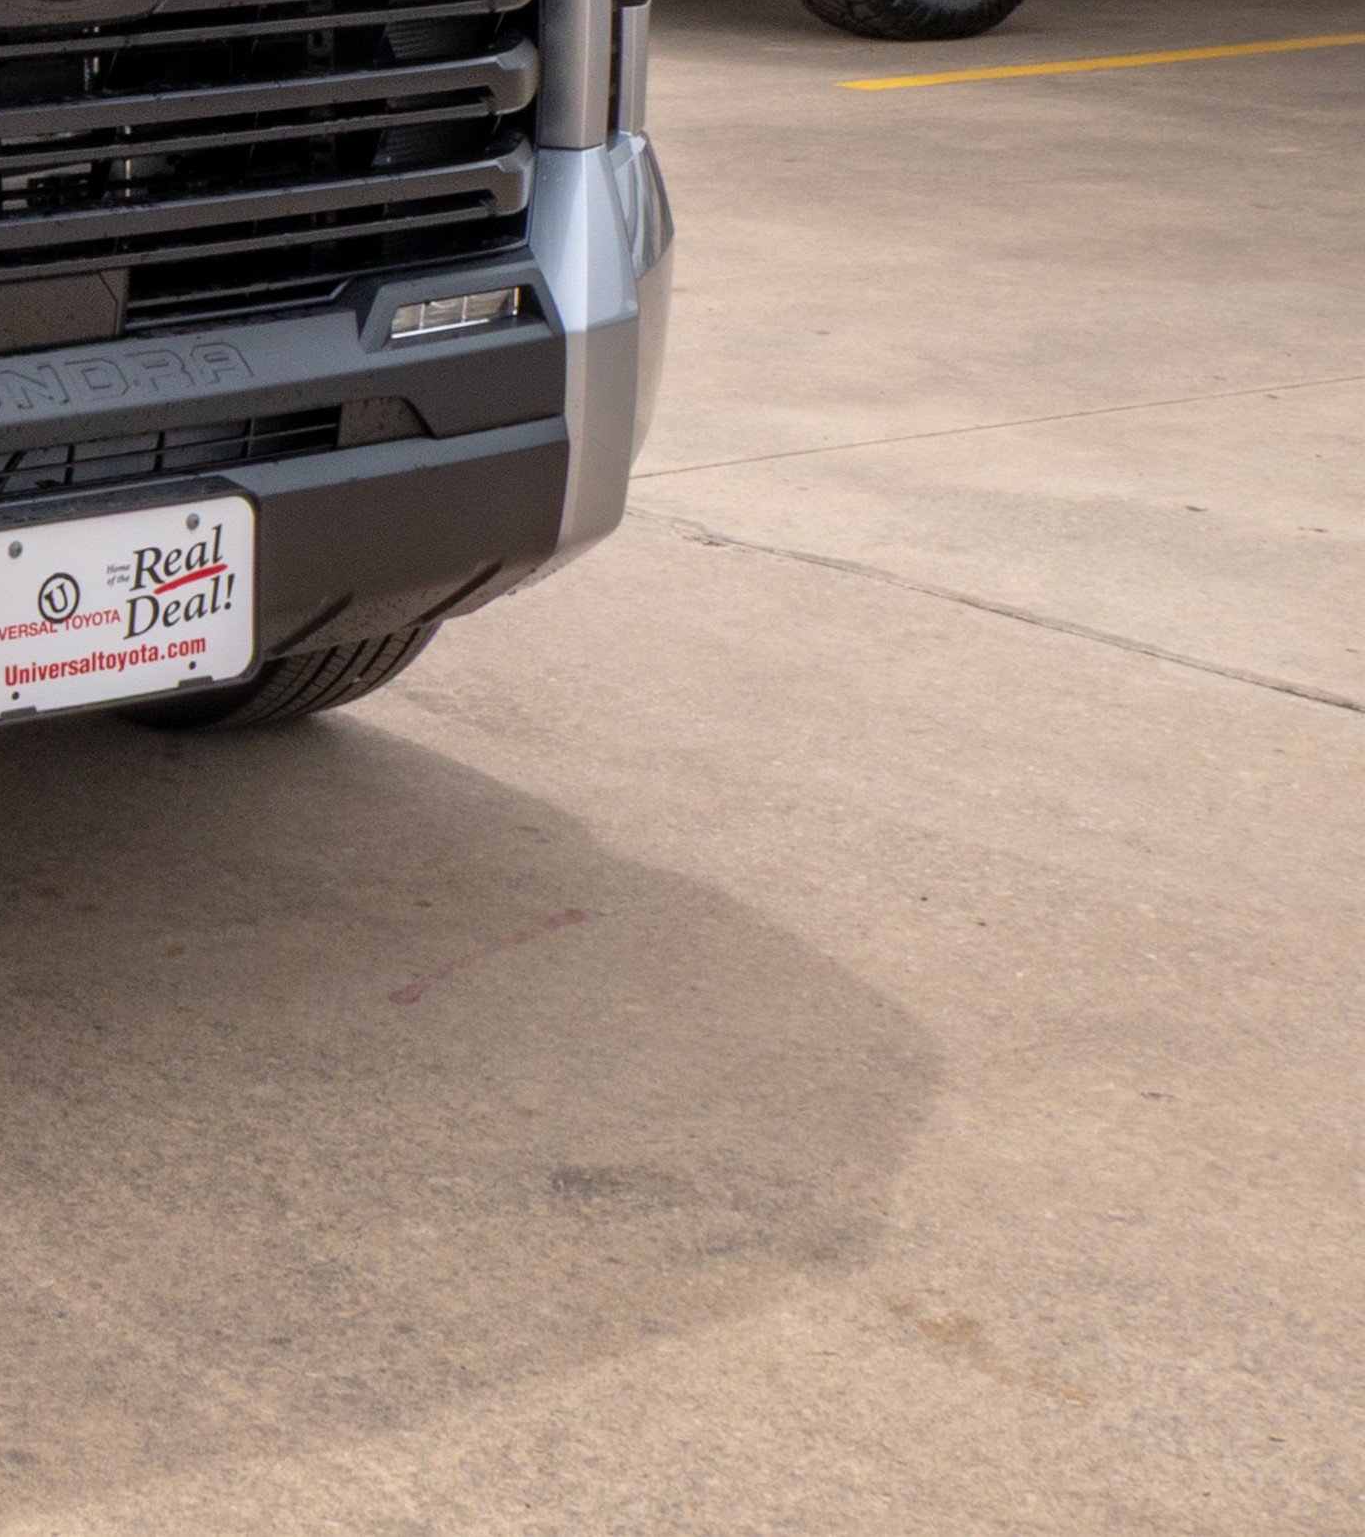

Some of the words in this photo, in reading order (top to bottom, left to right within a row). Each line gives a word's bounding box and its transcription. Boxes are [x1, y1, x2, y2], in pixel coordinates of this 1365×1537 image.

[106, 564, 131, 575] Home
[129, 523, 224, 591] Real
[63, 608, 121, 632] TOYOTA
[123, 573, 236, 640] Deal!
[4, 636, 207, 687] Universaltoyota.com
